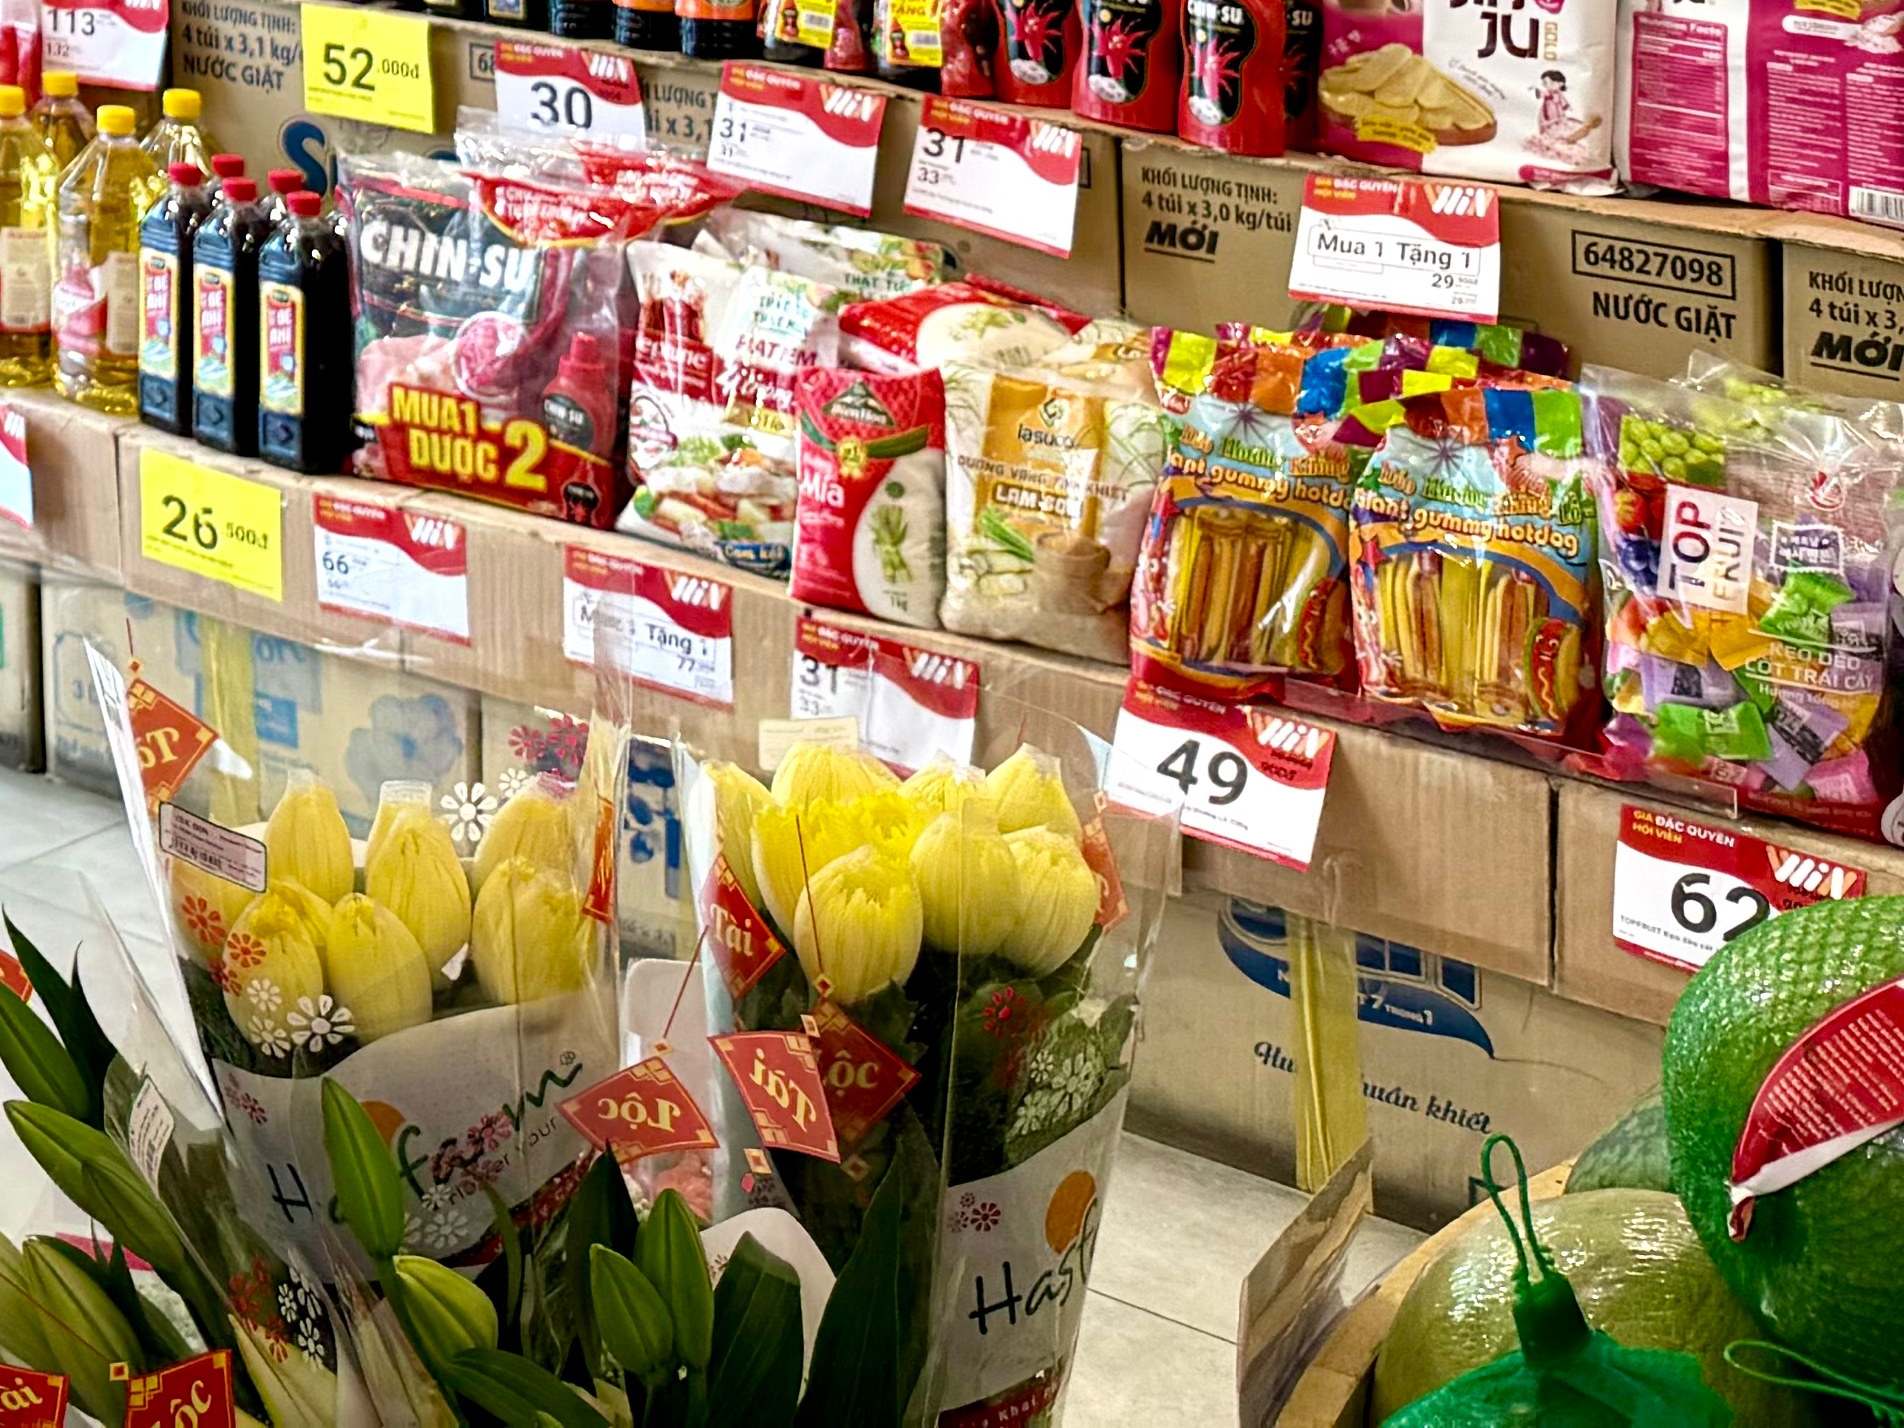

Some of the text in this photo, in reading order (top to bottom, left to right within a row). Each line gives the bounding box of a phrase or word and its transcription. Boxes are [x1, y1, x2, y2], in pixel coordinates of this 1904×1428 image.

[47, 9, 97, 37] 113
[1477, 12, 1539, 59] JU
[323, 43, 376, 91] 52
[530, 80, 593, 131] 30
[720, 117, 747, 143] 31
[923, 126, 965, 164] 31
[1141, 166, 1279, 209] KHỐI LƯỢNG TỊNH:
[1142, 190, 1292, 234] 4 túi x 3,0 kg/túi
[360, 219, 537, 293] CHIN-SU
[1145, 219, 1220, 256] MỚI
[1316, 232, 1470, 271] Mua 1 Tặng 1
[1431, 273, 1454, 290] 29
[1584, 240, 1724, 287] 64827098
[1593, 290, 1737, 344] NƯỚC GIẶT
[504, 420, 548, 493] 2
[162, 494, 218, 550] 26
[1669, 501, 1712, 590] TOP
[322, 550, 350, 574] 66
[1157, 739, 1248, 806] 49
[1671, 873, 1770, 942] 62
